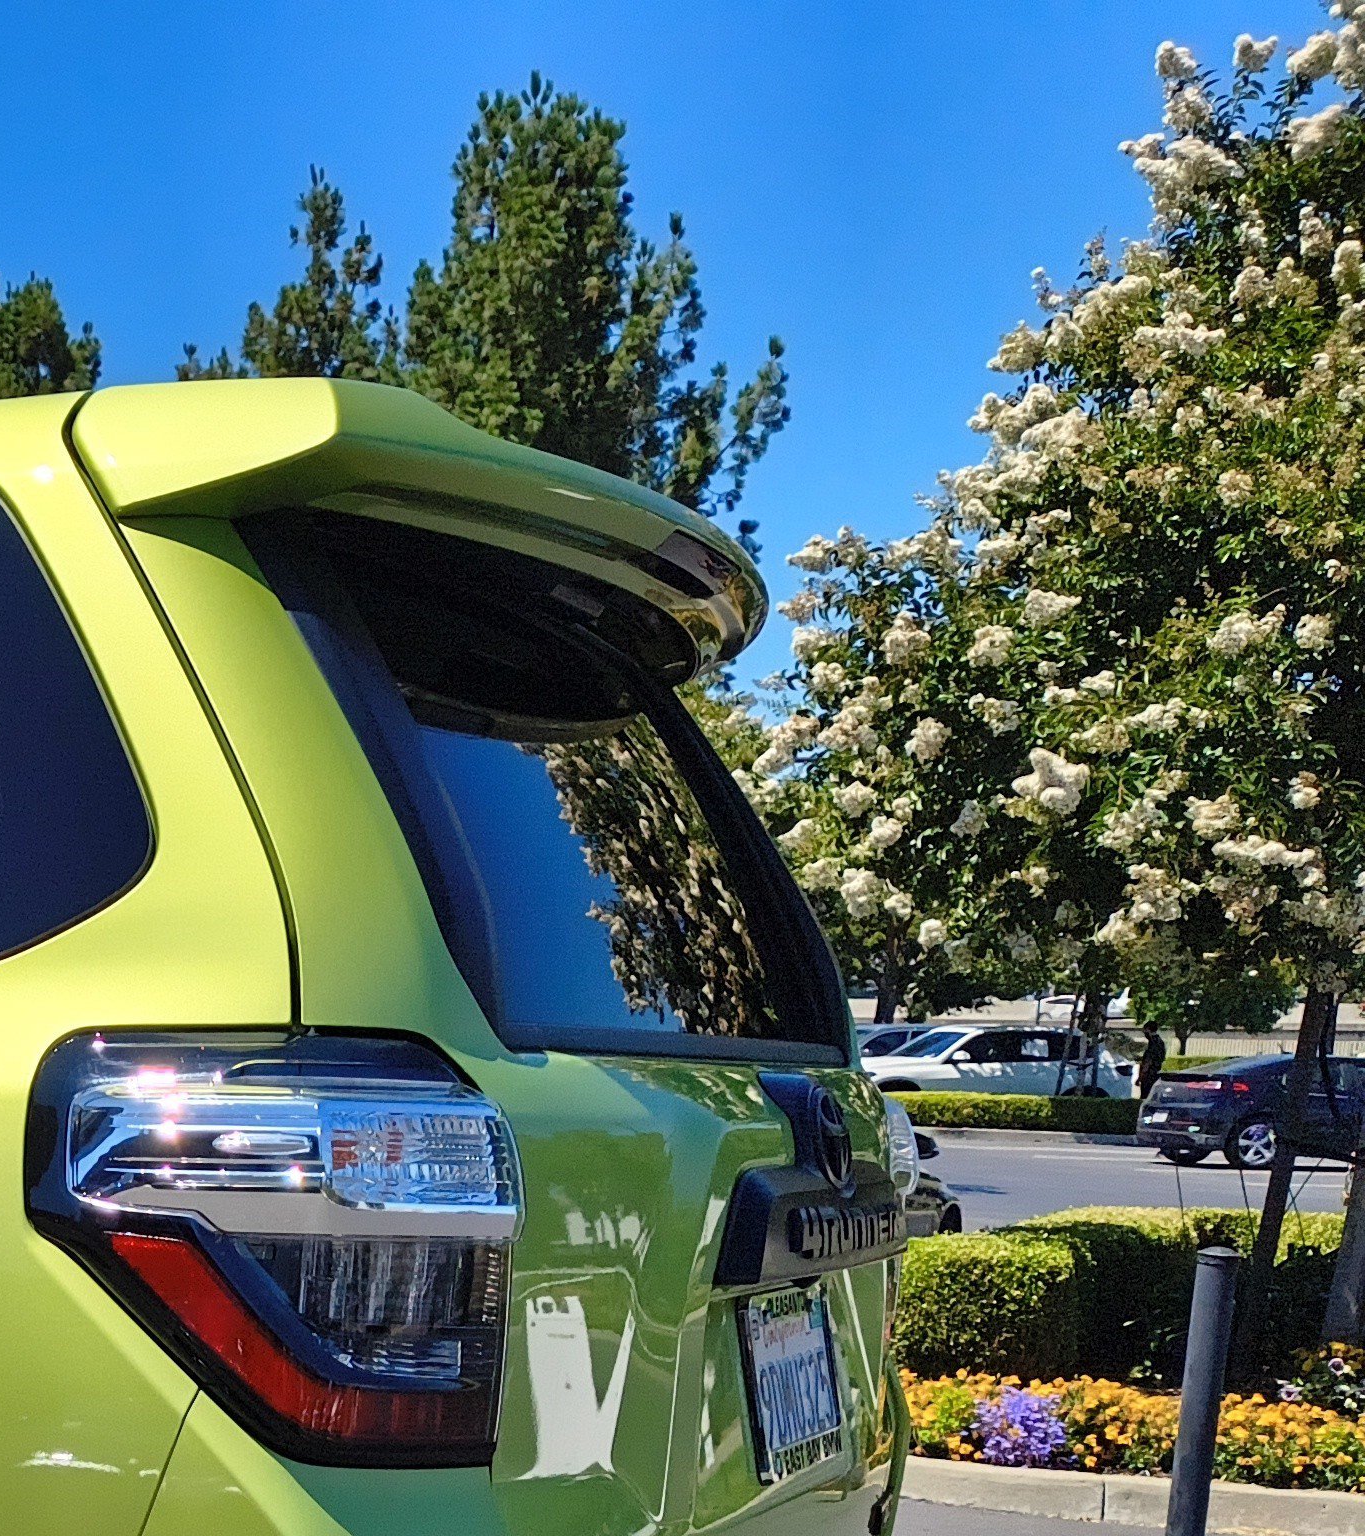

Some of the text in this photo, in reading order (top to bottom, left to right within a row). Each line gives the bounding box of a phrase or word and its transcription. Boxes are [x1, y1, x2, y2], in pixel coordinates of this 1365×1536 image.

[784, 1428, 843, 1475] EAST BAY BMW
